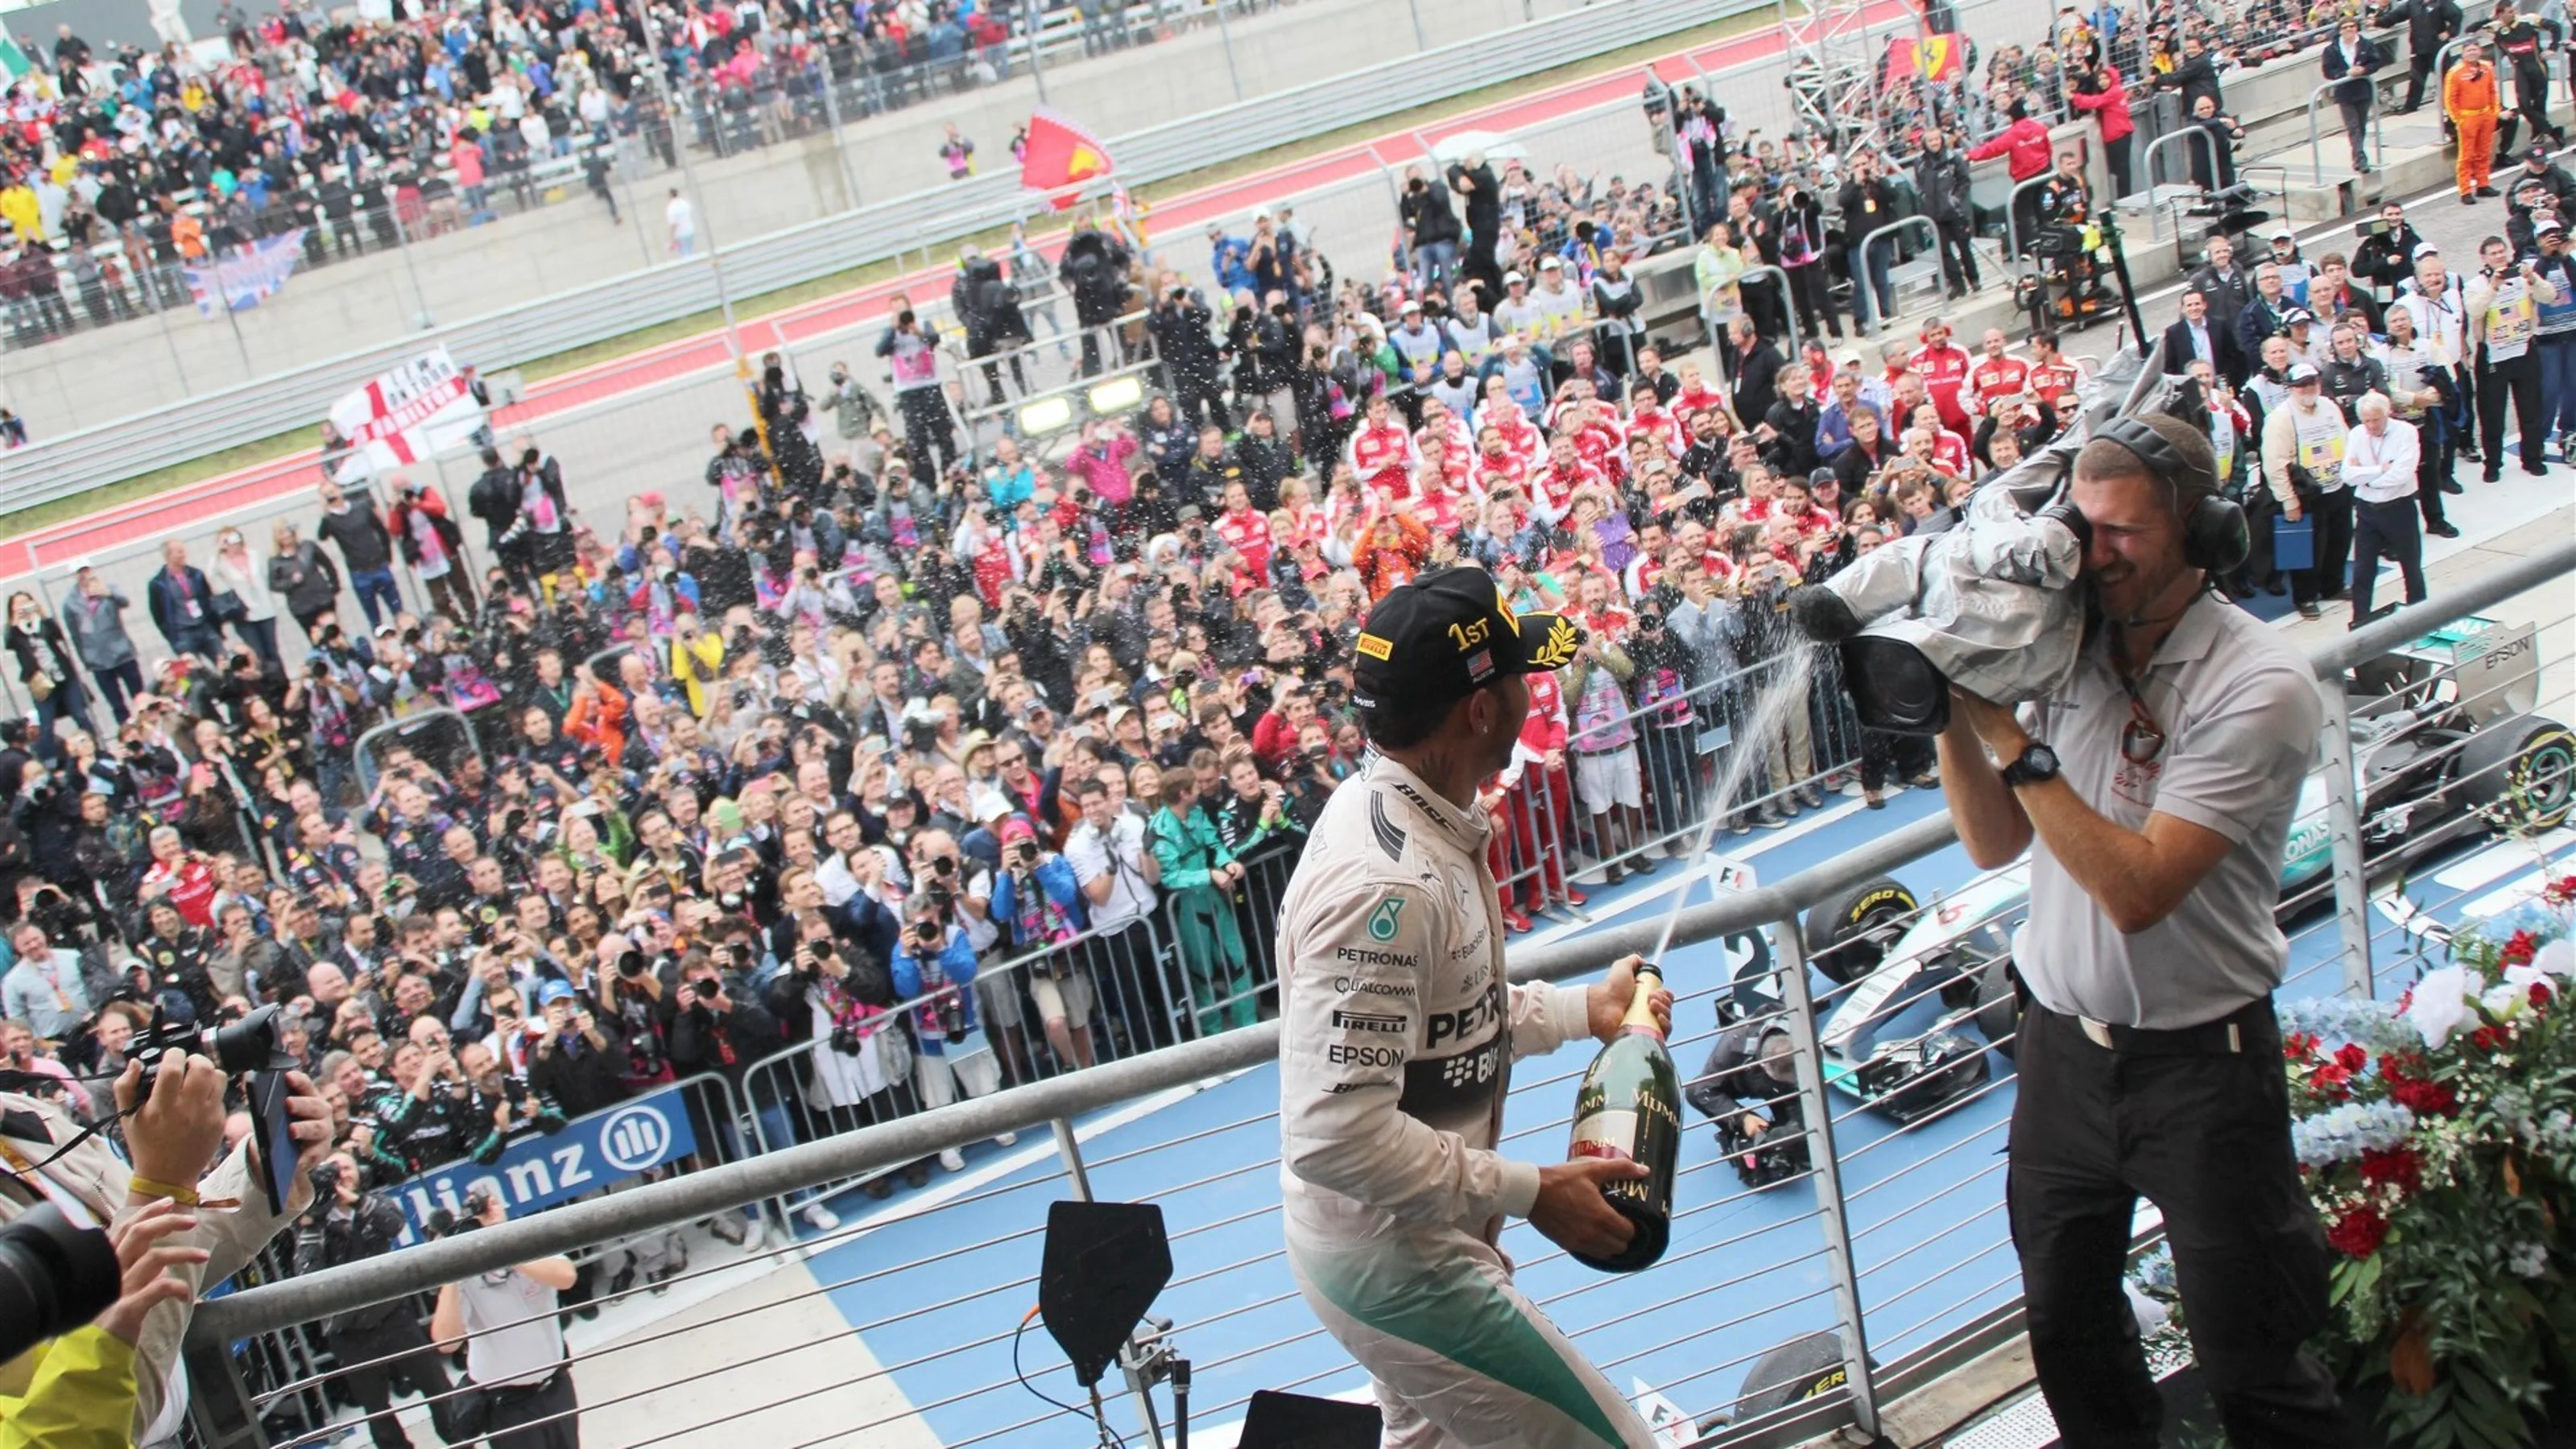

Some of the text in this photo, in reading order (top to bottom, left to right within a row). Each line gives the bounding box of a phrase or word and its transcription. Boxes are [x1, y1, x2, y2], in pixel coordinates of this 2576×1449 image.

[1448, 617, 1491, 652] 1ST
[2485, 636, 2531, 671] EPSON
[1850, 889, 1896, 923] ZERO
[1337, 947, 1418, 968] PETRONAS
[1723, 926, 1783, 1017] 2
[1333, 976, 1416, 997] QUALCOMM
[1331, 1009, 1408, 1034] PIRELLI
[1329, 1044, 1404, 1068] EPSON
[390, 1143, 593, 1247] llianz
